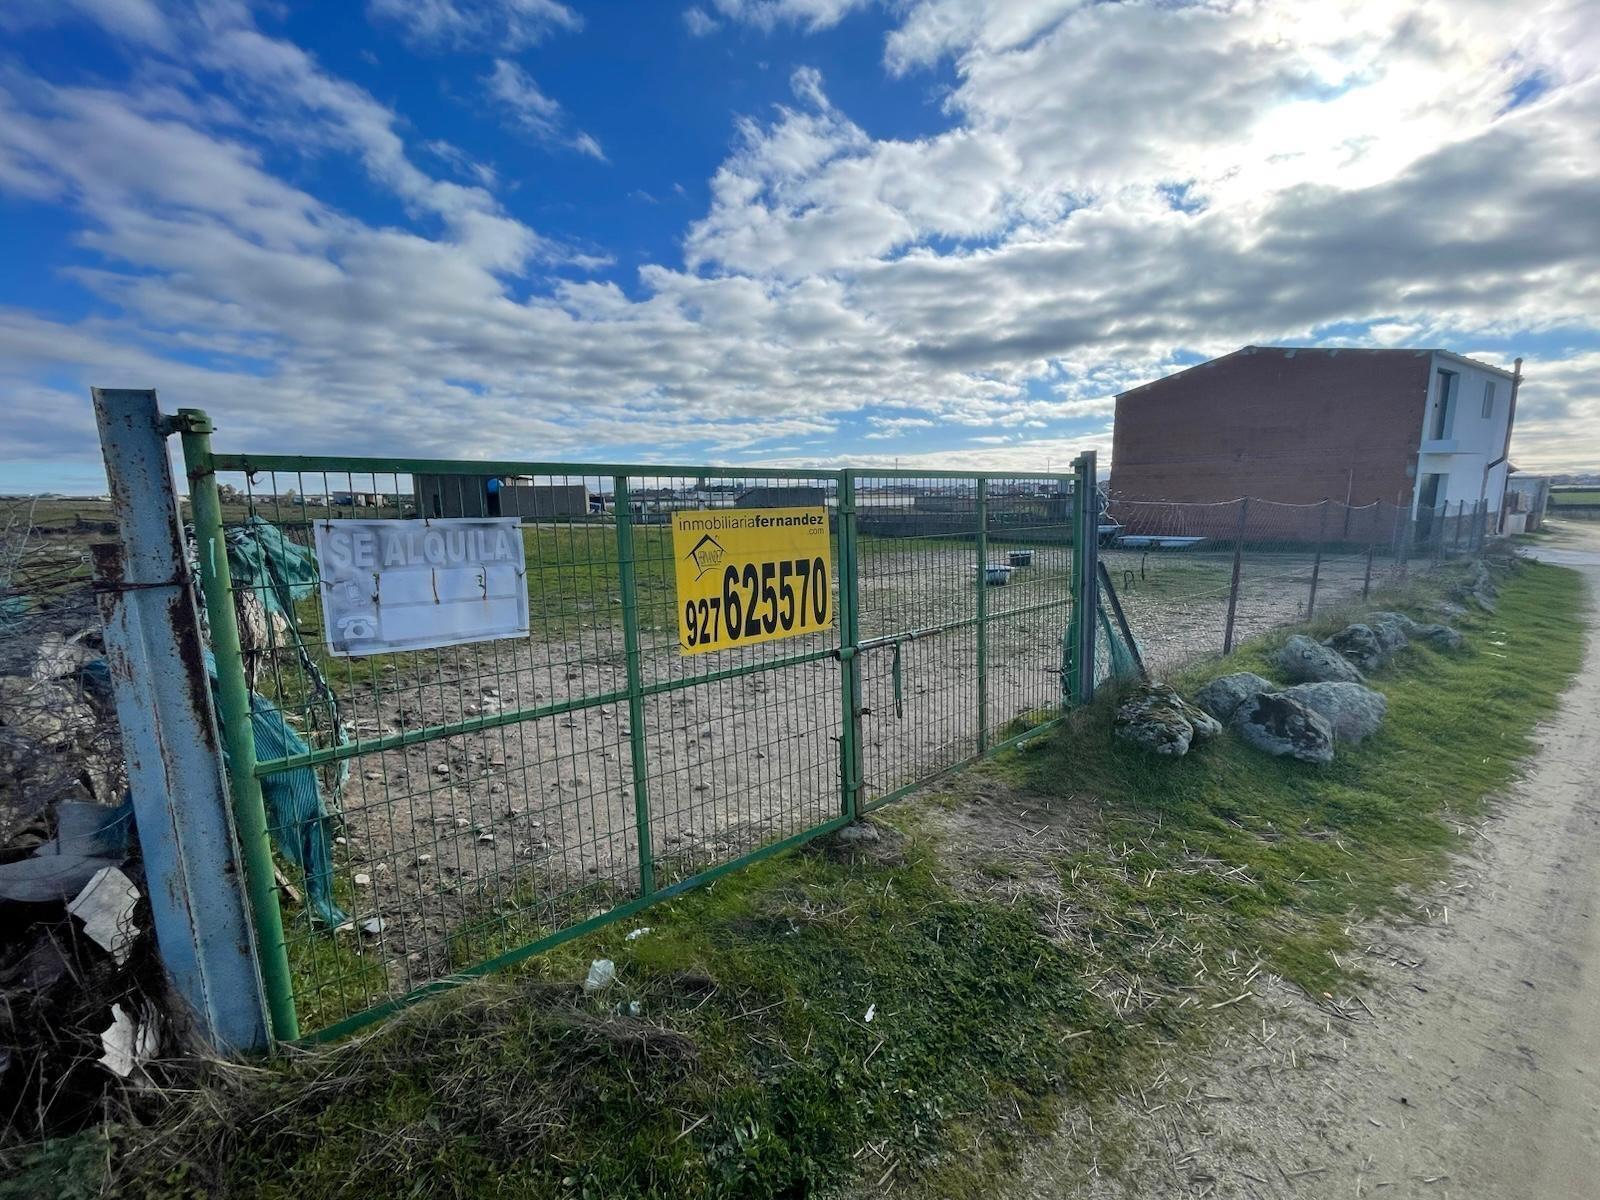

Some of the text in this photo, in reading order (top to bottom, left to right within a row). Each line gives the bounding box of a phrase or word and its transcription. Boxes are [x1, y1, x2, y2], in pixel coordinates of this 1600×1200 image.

[679, 513, 824, 531] inmobiliariafernandez
[329, 529, 514, 568] SE ALQUILA
